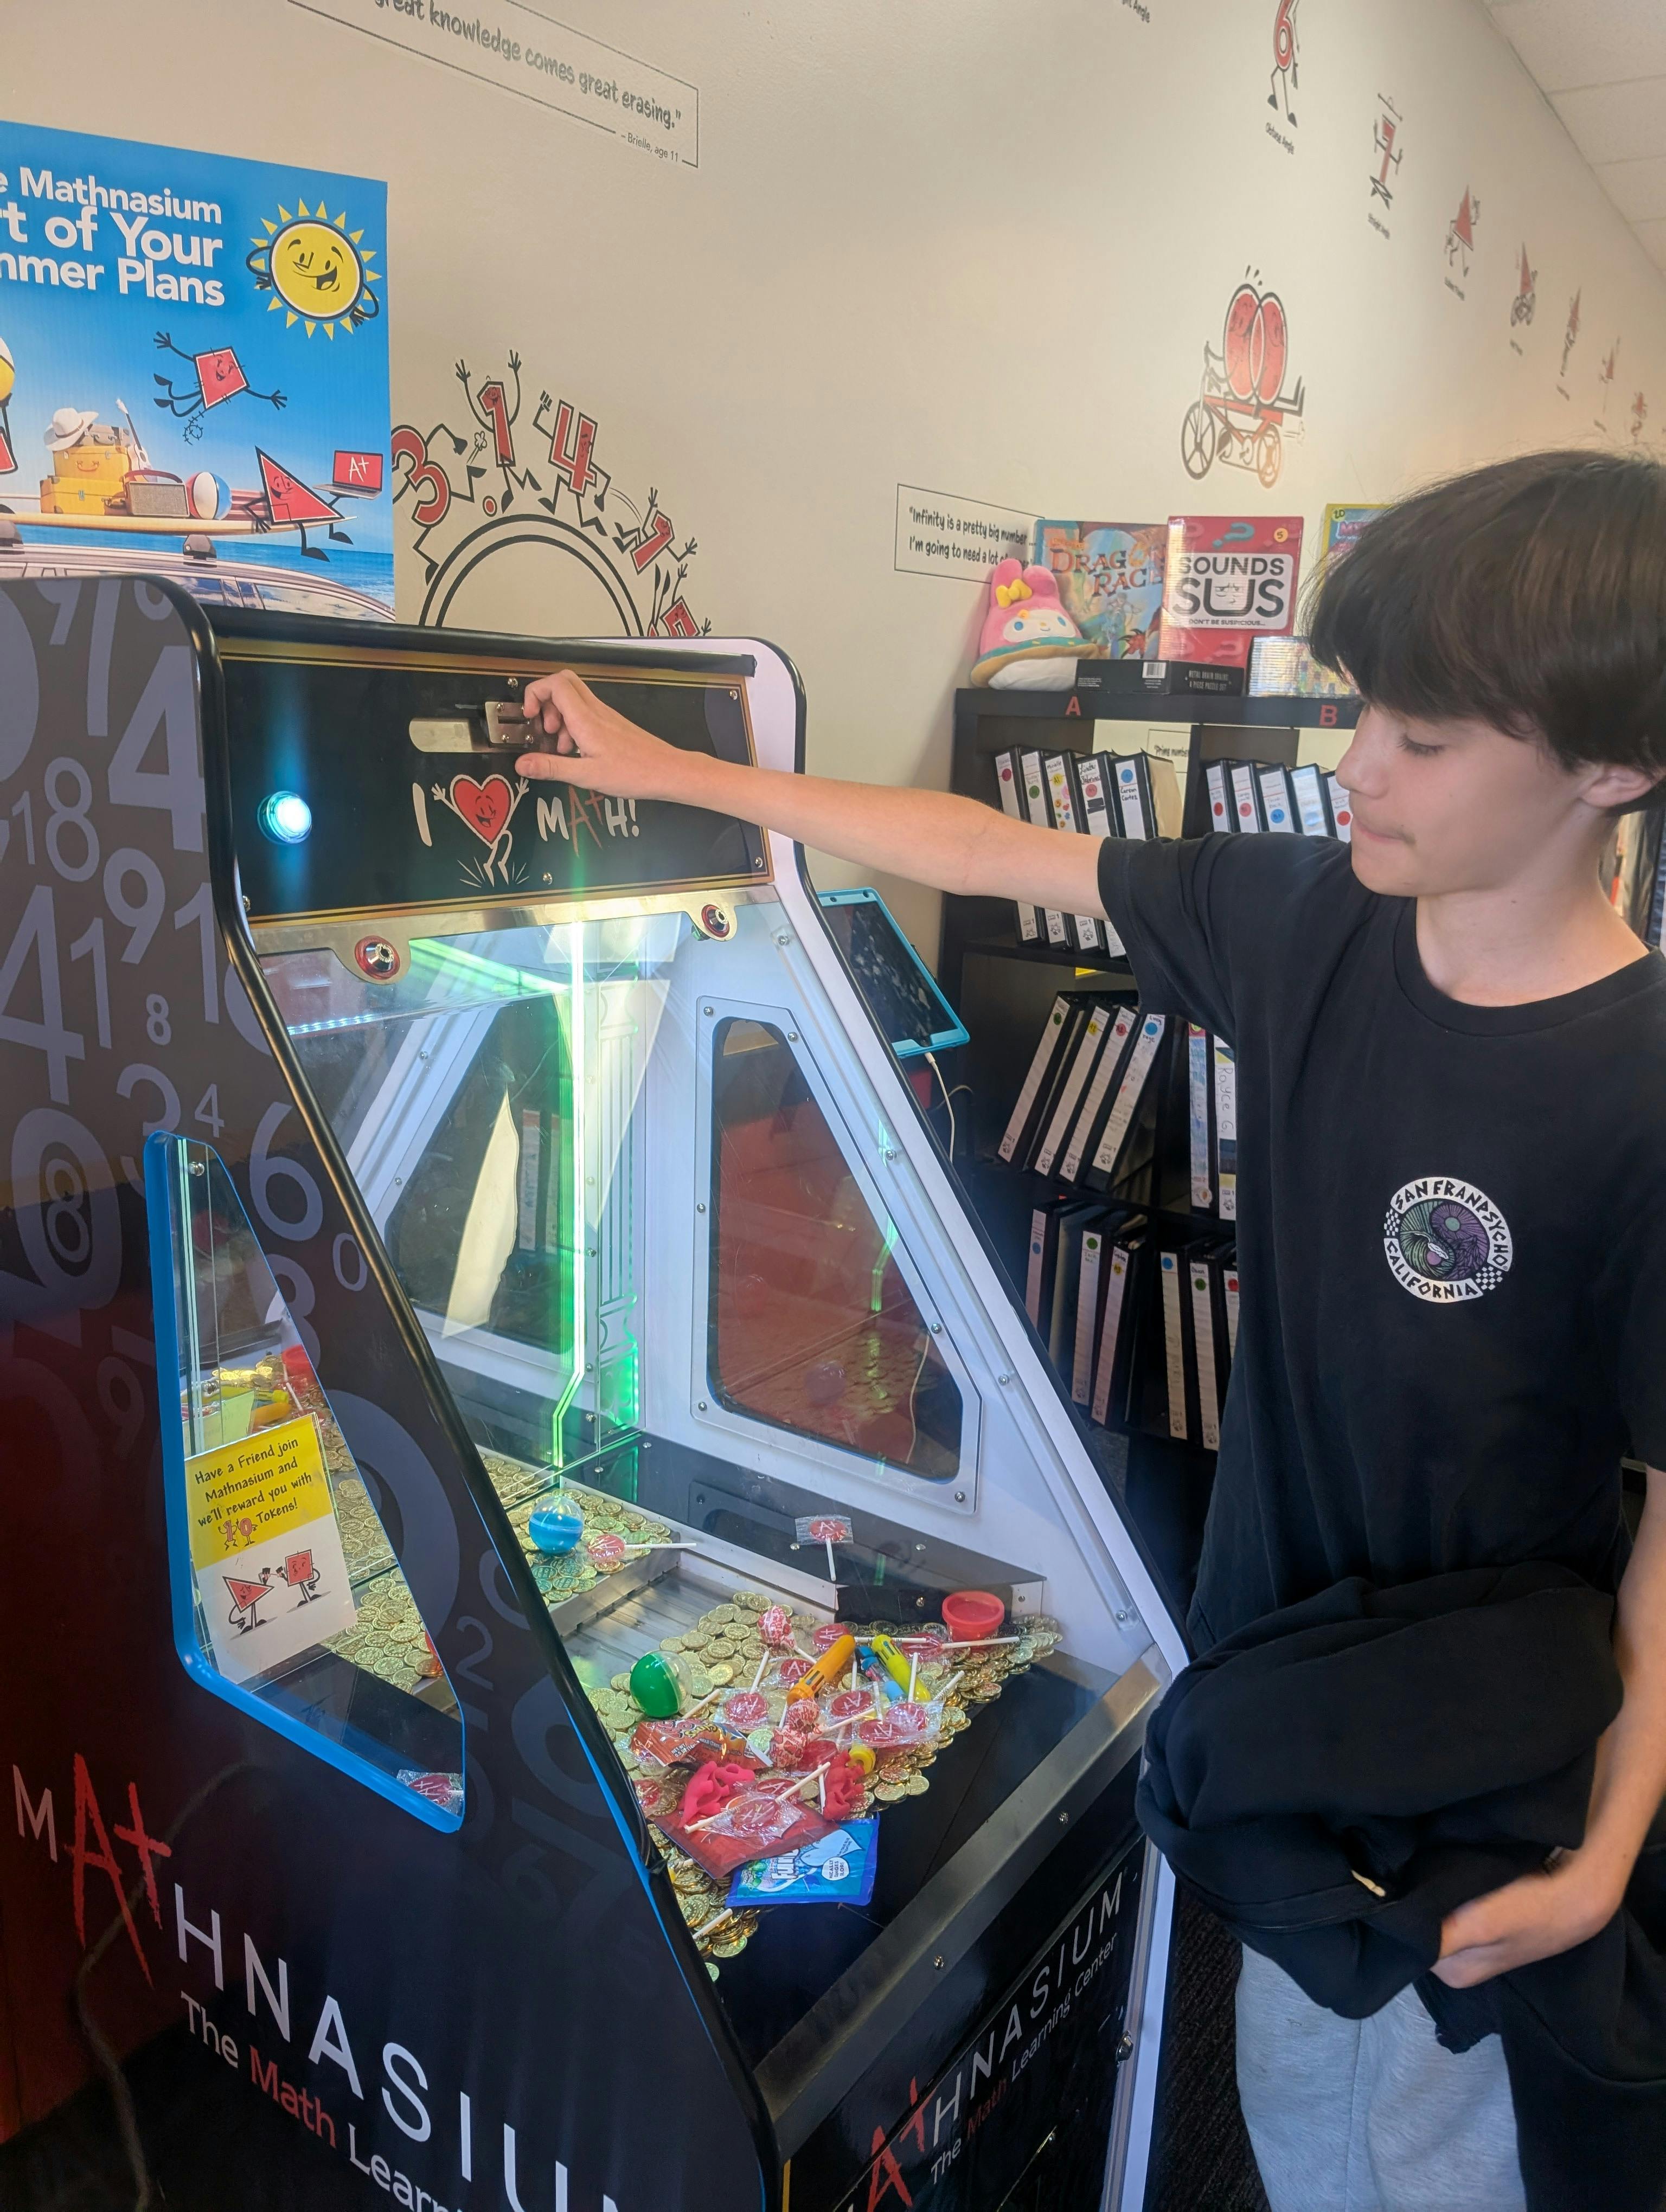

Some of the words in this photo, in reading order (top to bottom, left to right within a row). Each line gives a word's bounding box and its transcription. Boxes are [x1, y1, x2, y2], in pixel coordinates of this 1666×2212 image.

[429, 0, 522, 61] knowledge
[525, 48, 575, 85] comes
[578, 72, 619, 103] great
[621, 91, 682, 130] erasing."
[627, 132, 653, 153] Brielle,
[655, 146, 668, 159] age
[670, 150, 679, 162] 11
[20, 166, 222, 225] Mathnasium
[45, 205, 98, 252] of
[110, 212, 223, 268] Your
[118, 258, 225, 306] Plans
[348, 456, 369, 482] A+
[909, 536, 924, 552] I'm
[925, 540, 949, 559] going
[952, 543, 961, 558] to
[963, 547, 981, 562] need
[982, 554, 986, 563] a
[988, 549, 998, 565] lot
[947, 515, 954, 530] is
[956, 522, 961, 531] a
[963, 520, 987, 539] pretty
[989, 523, 999, 542] big
[1001, 530, 1028, 545] number
[1178, 556, 1284, 576] SOUNDS
[1172, 577, 1285, 618] SUS
[1065, 697, 1081, 716] A
[1319, 705, 1338, 726] B
[412, 783, 433, 847] I
[145, 993, 171, 1046] 8
[1386, 1240, 1479, 1300] CALIFORNIA
[195, 1468, 223, 1484] Have
[227, 1463, 234, 1473] a
[238, 1444, 275, 1469] Friend
[277, 1438, 299, 1457] join
[205, 1468, 274, 1502] Mathnasium
[278, 1456, 298, 1475] and
[197, 1509, 222, 1527] we'll
[226, 1490, 265, 1516] reward
[268, 1484, 287, 1502] you
[291, 1472, 312, 1489] with
[255, 1497, 299, 1524] Tokens!
[787, 1662, 810, 1676] A+
[12, 1753, 619, 2212] MATHNASIU
[846, 1872, 1123, 2212] ATHNASIUM
[931, 2137, 961, 2185] The
[1011, 1988, 1072, 2082] Learning
[1074, 1932, 1117, 1997] Center
[180, 1990, 238, 2068] The
[249, 2045, 337, 2148] Math
[348, 2123, 463, 2212] Lear
